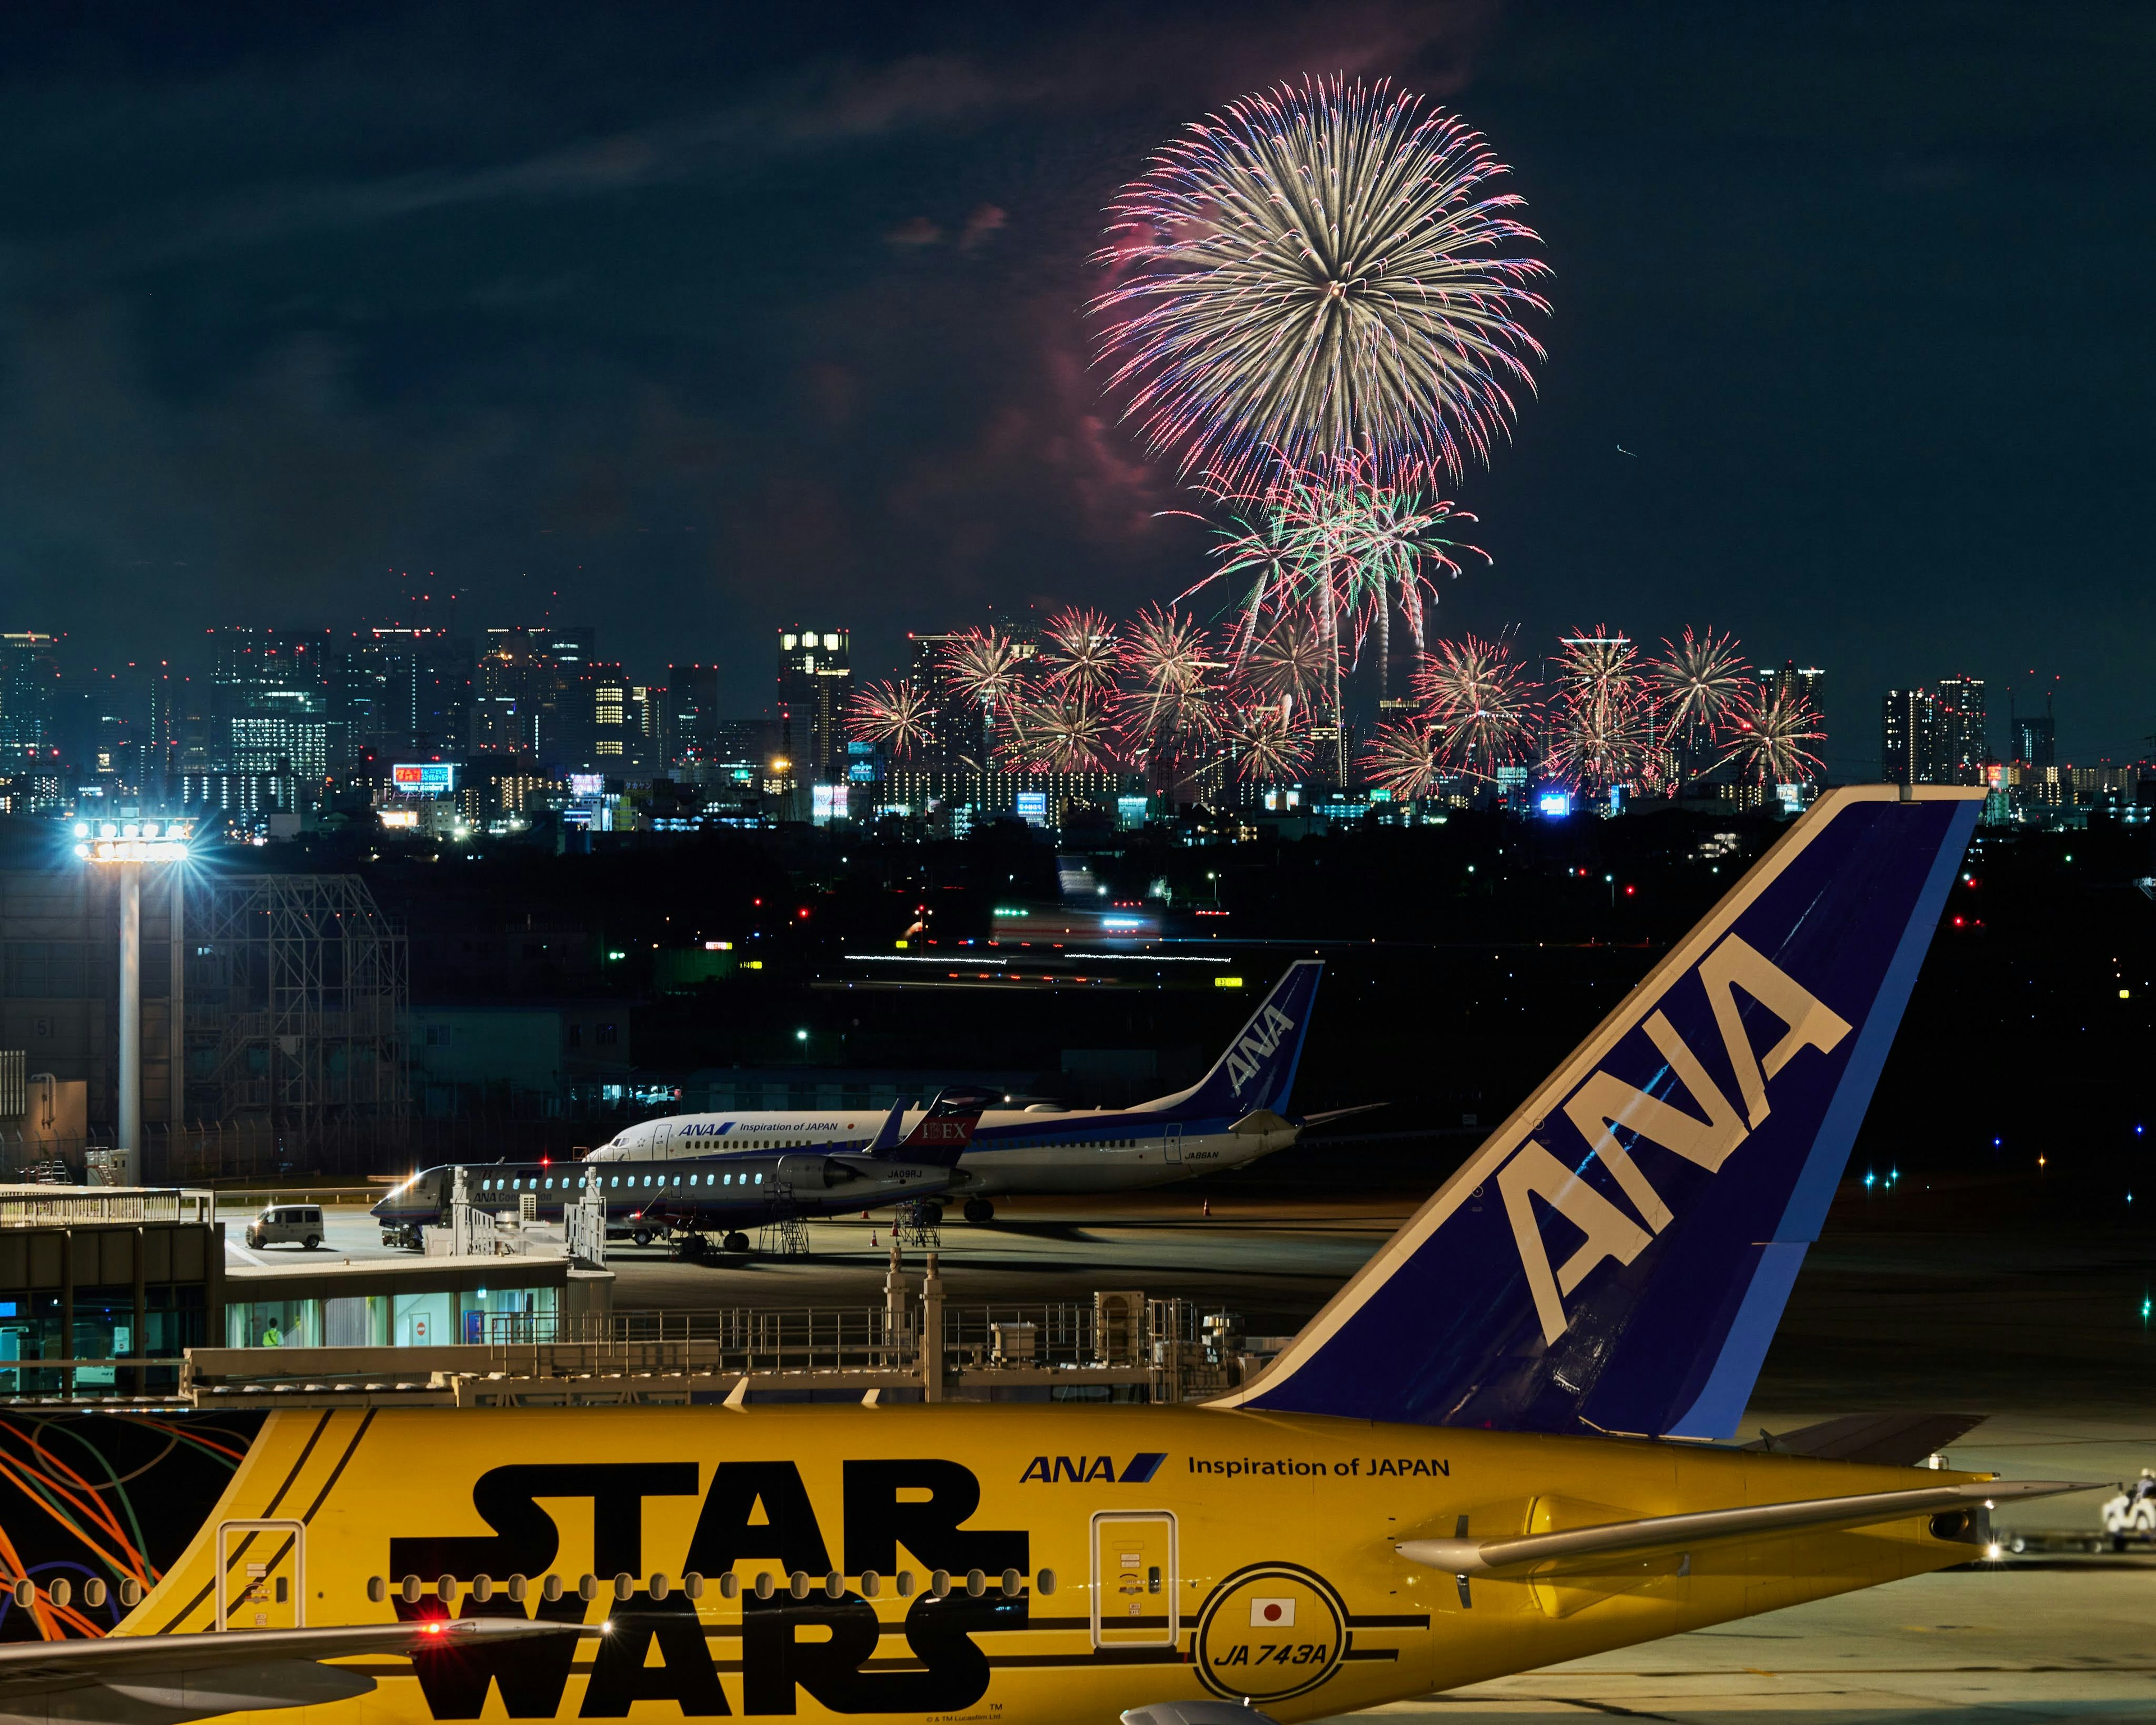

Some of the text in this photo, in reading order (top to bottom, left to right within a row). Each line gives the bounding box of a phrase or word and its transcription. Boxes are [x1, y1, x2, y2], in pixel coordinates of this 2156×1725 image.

[1226, 1004, 1295, 1097] ANA
[679, 1124, 715, 1136] ANA
[740, 1123, 791, 1133] Inspiration
[805, 1122, 838, 1131] JAPAN
[922, 1123, 967, 1139] IBEX
[1497, 932, 1852, 1347] ANA
[888, 1170, 922, 1178] JA09RJ
[473, 1192, 497, 1203] ANA
[1019, 1456, 1450, 1483] ANA Inspiration of JAPAN
[390, 1459, 1030, 1583] STAR
[391, 1586, 1029, 1721] WARS
[1214, 1644, 1327, 1666] JA 743A
